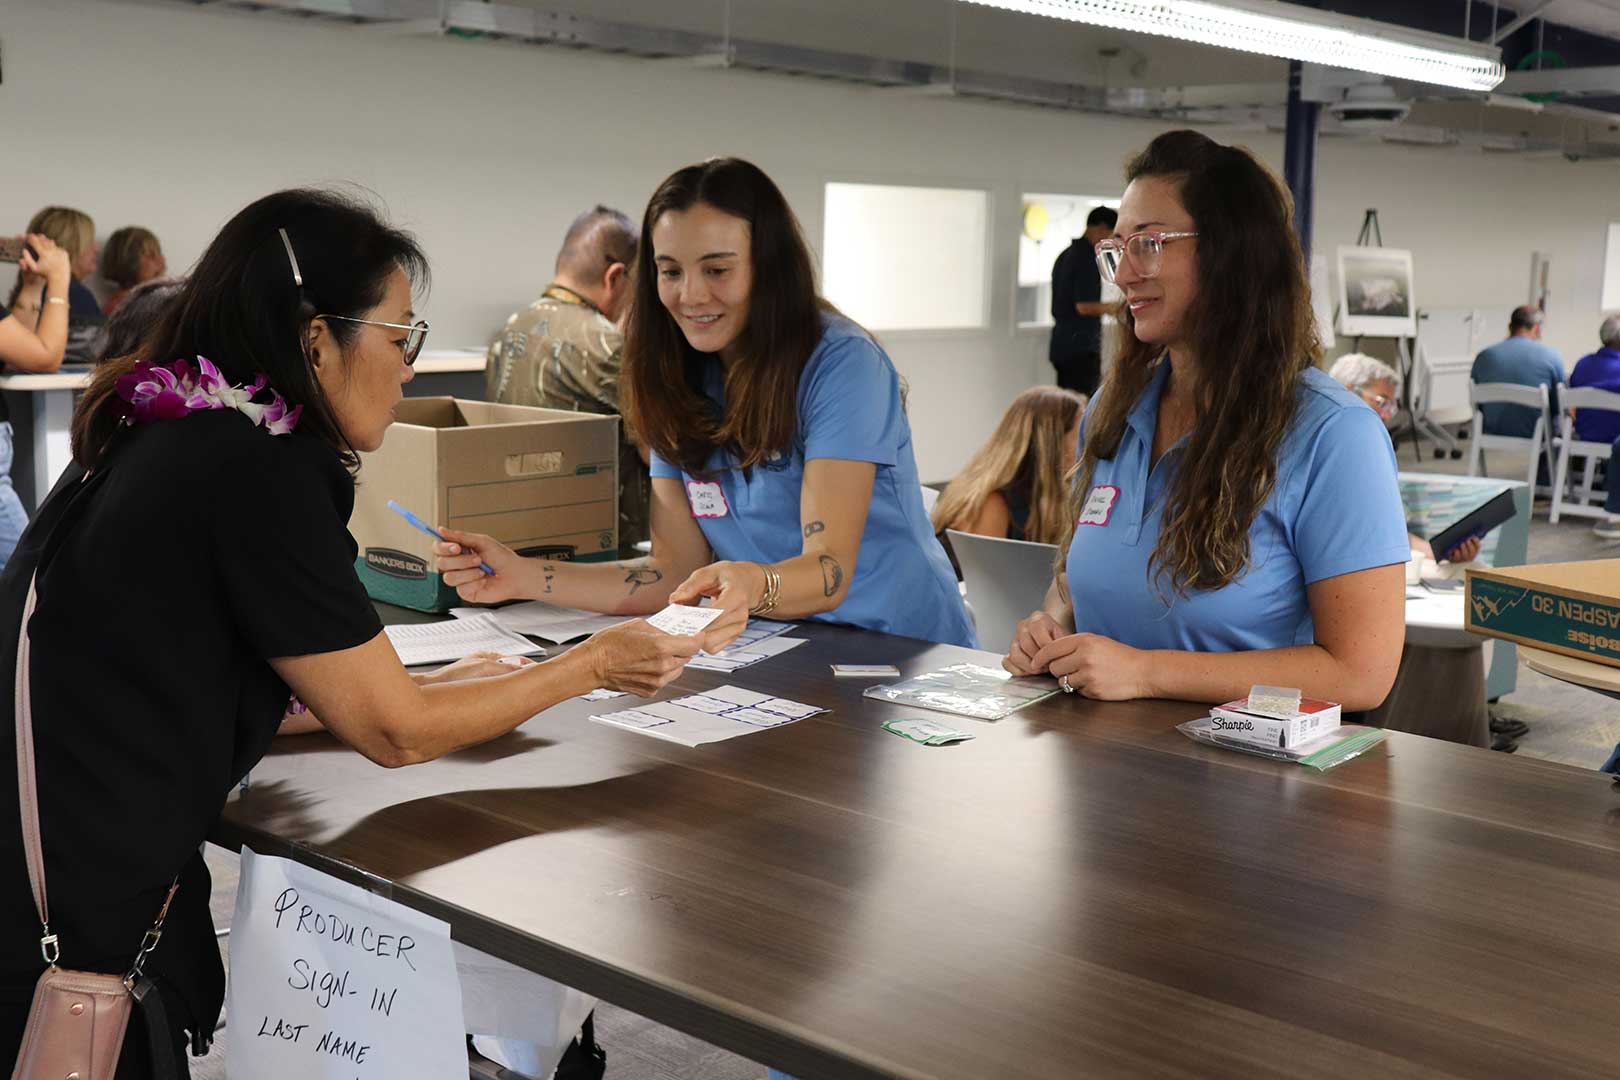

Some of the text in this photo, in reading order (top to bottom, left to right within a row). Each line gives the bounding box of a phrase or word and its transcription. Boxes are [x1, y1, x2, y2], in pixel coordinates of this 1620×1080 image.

[406, 561, 424, 573] BOX
[1531, 595, 1620, 629] ASPEN 30
[1211, 716, 1254, 733] Sharpie
[274, 887, 416, 971] PRODUCER
[370, 987, 397, 1016] IN
[257, 1016, 370, 1064] LAST NAME
